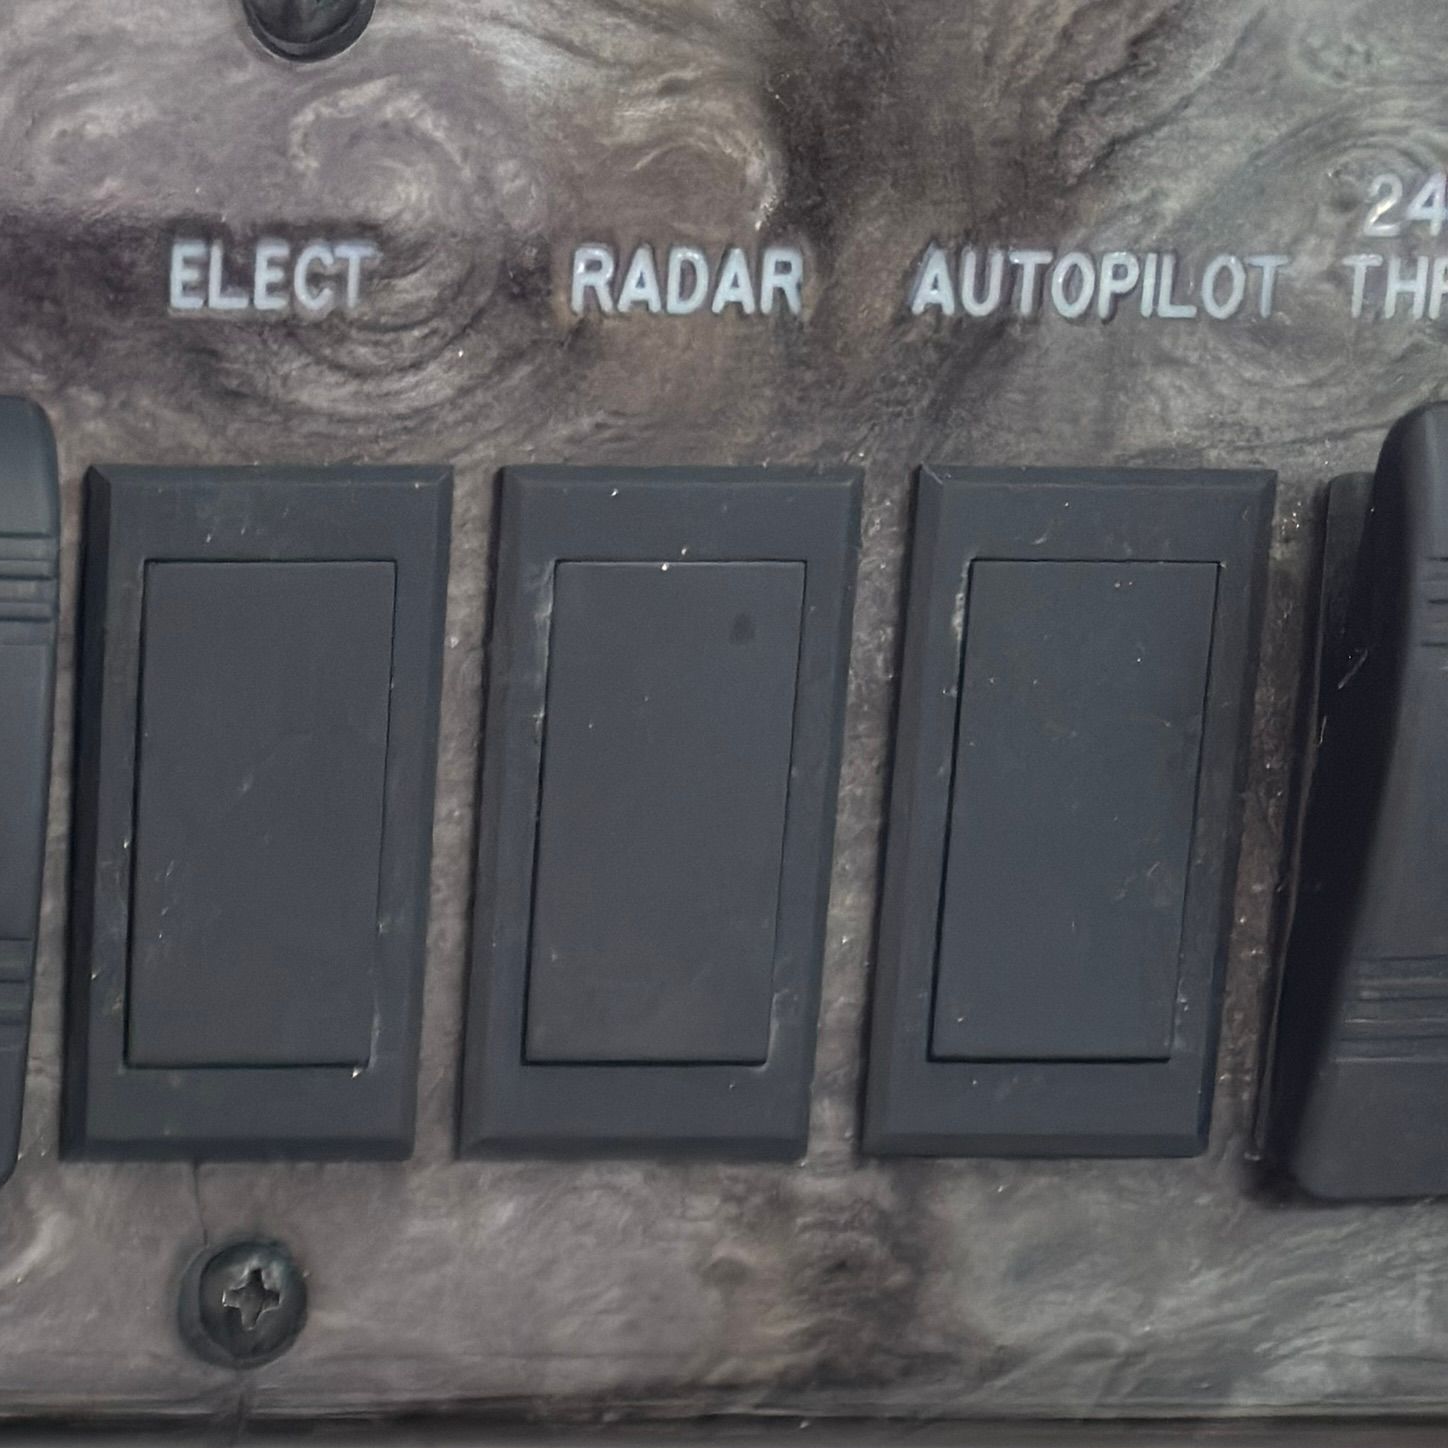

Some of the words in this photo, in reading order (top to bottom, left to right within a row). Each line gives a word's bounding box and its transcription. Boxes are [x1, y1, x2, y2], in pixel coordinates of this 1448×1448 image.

[168, 240, 379, 312] ELECT
[570, 244, 806, 314] RADAR
[912, 252, 1290, 322] AUTOPILOT
